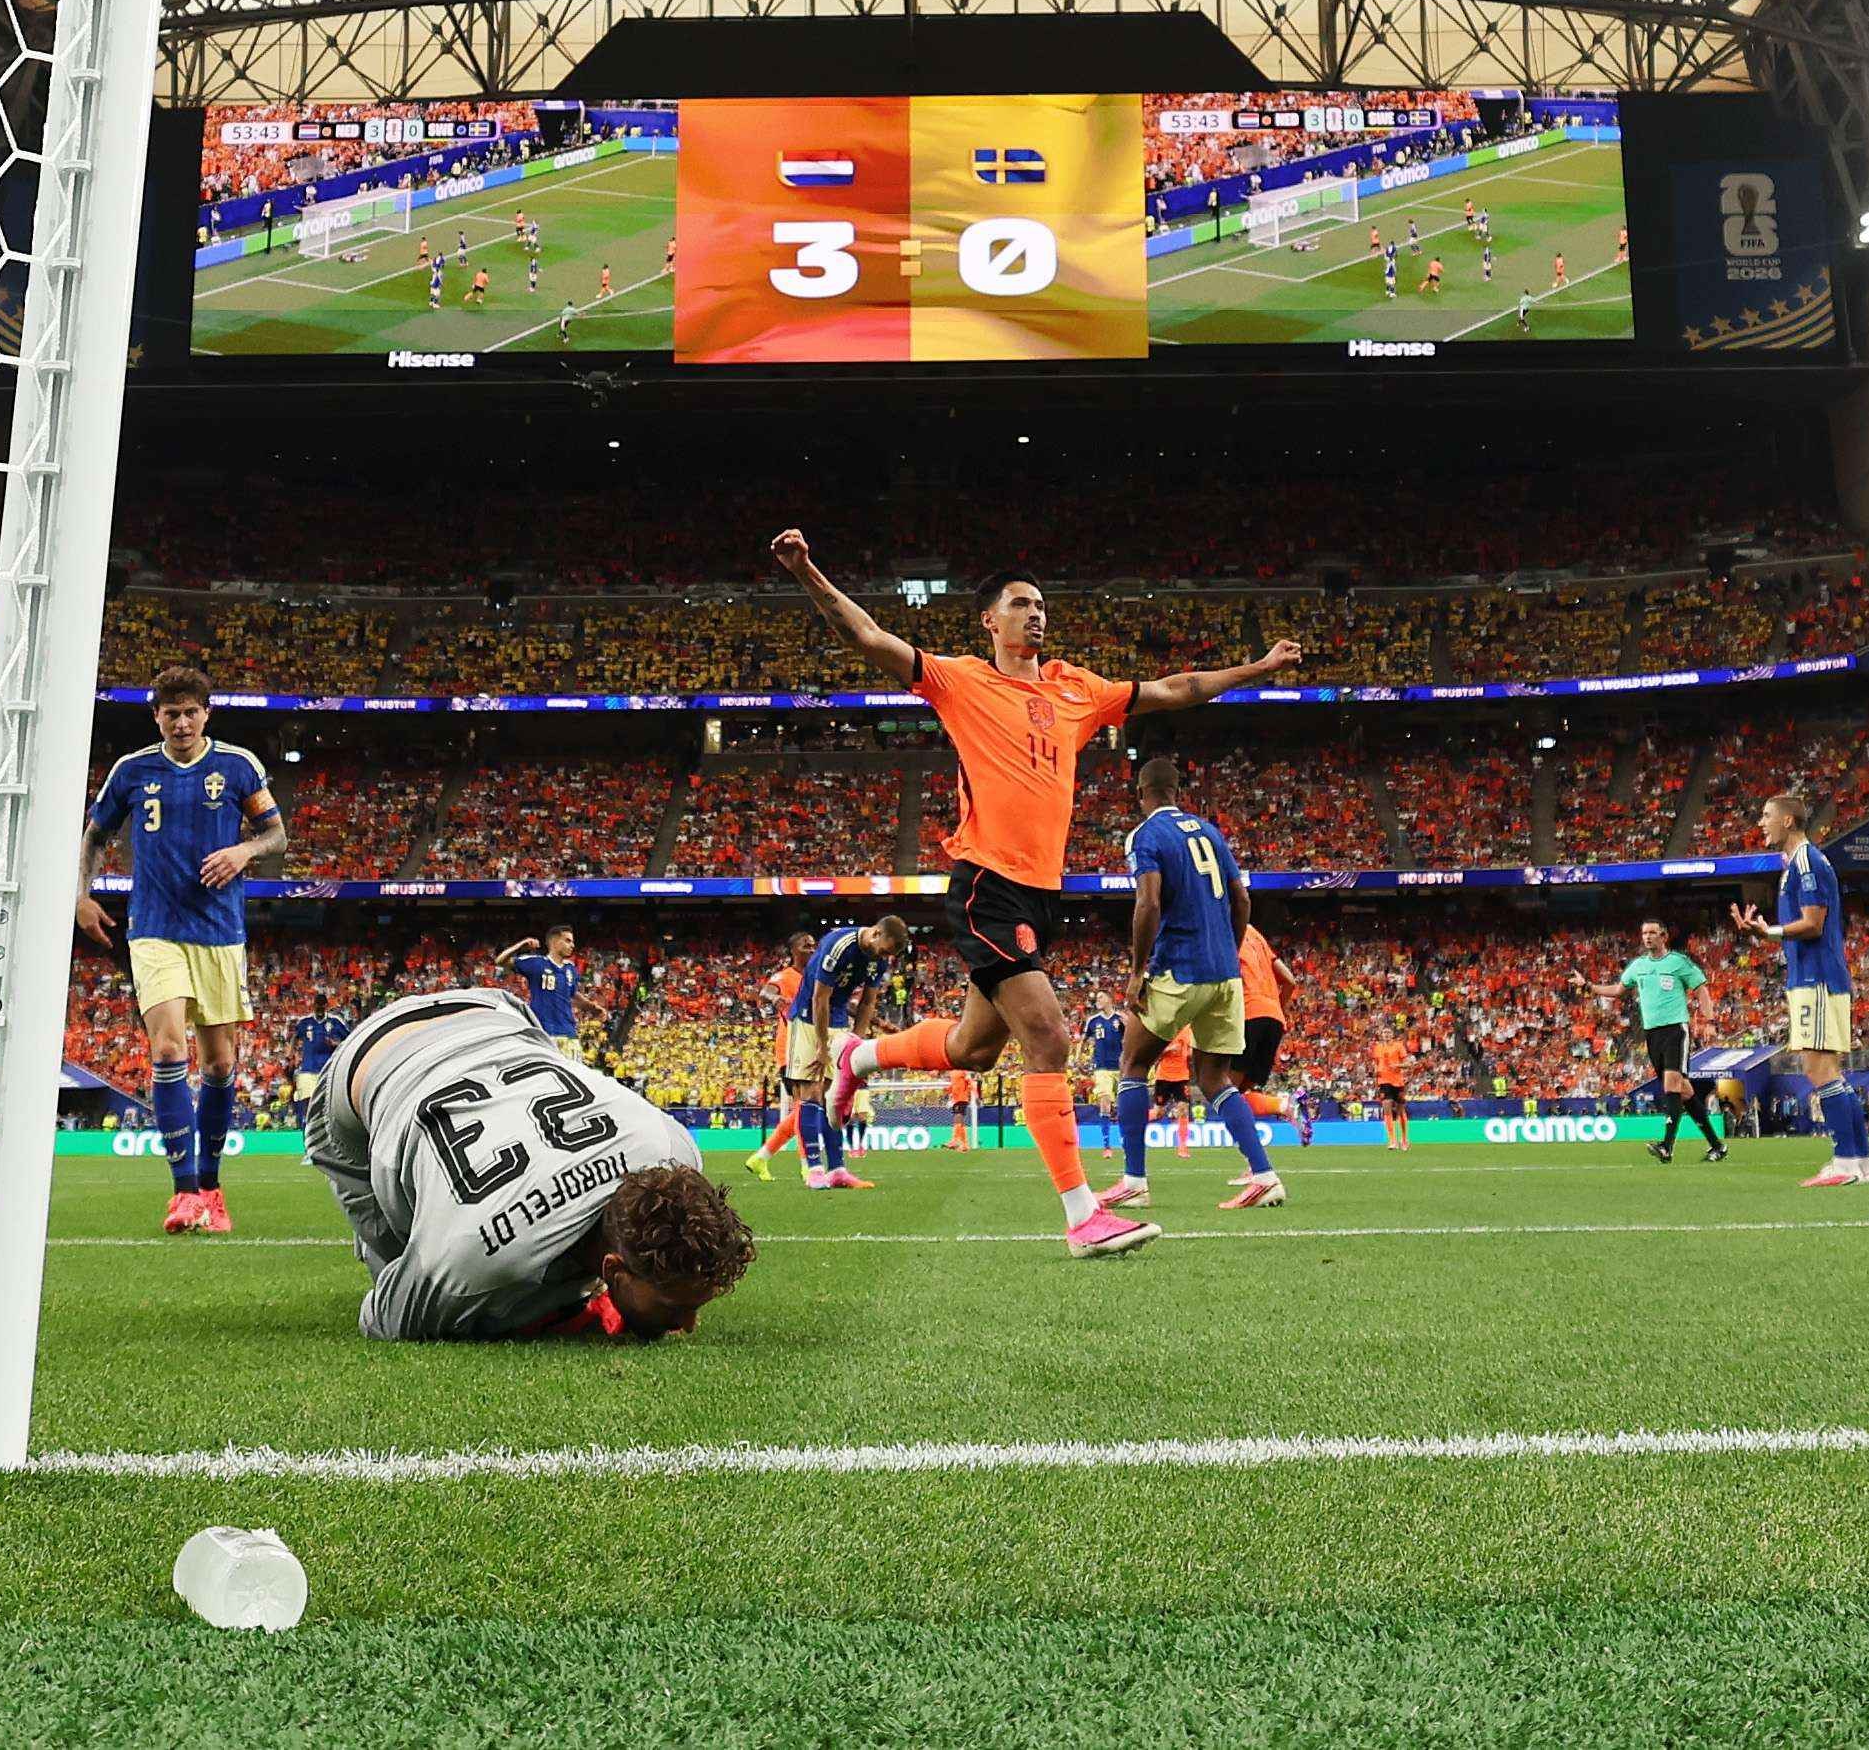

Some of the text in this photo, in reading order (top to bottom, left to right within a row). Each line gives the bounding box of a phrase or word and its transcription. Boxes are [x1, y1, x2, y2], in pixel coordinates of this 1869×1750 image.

[1171, 114, 1219, 128] 53:43
[1310, 113, 1320, 126] 3
[1350, 113, 1359, 125] 0
[232, 125, 280, 140] 53:43
[369, 124, 379, 138] 3
[408, 124, 418, 138] 0
[436, 170, 484, 200] aramco
[1382, 164, 1430, 190] aramco
[769, 216, 1058, 298] 3 0
[1726, 257, 1760, 266] WORLD
[1348, 340, 1436, 357] Hisense
[388, 350, 476, 368] Hisense
[1796, 656, 1848, 673] HOUSTON
[1579, 678, 1604, 692] FIFA
[1603, 678, 1642, 690] WORLD
[1642, 675, 1662, 688] CUP
[1432, 686, 1484, 698] HOUSTON
[364, 698, 416, 710] HOUSTON
[719, 696, 772, 706] HOUSTON
[1026, 732, 1058, 774] 14
[143, 798, 162, 832] 3
[1188, 836, 1225, 900] 4
[1101, 876, 1130, 889] FIFA
[1398, 872, 1464, 885] HOUSTON
[380, 884, 446, 896] HOUSTON
[1800, 1005, 1811, 1026] 2
[1688, 1070, 1733, 1078] OUSTON
[416, 1060, 619, 1205] 23
[1144, 1122, 1272, 1148] aramo
[1484, 1116, 1618, 1143] aramco
